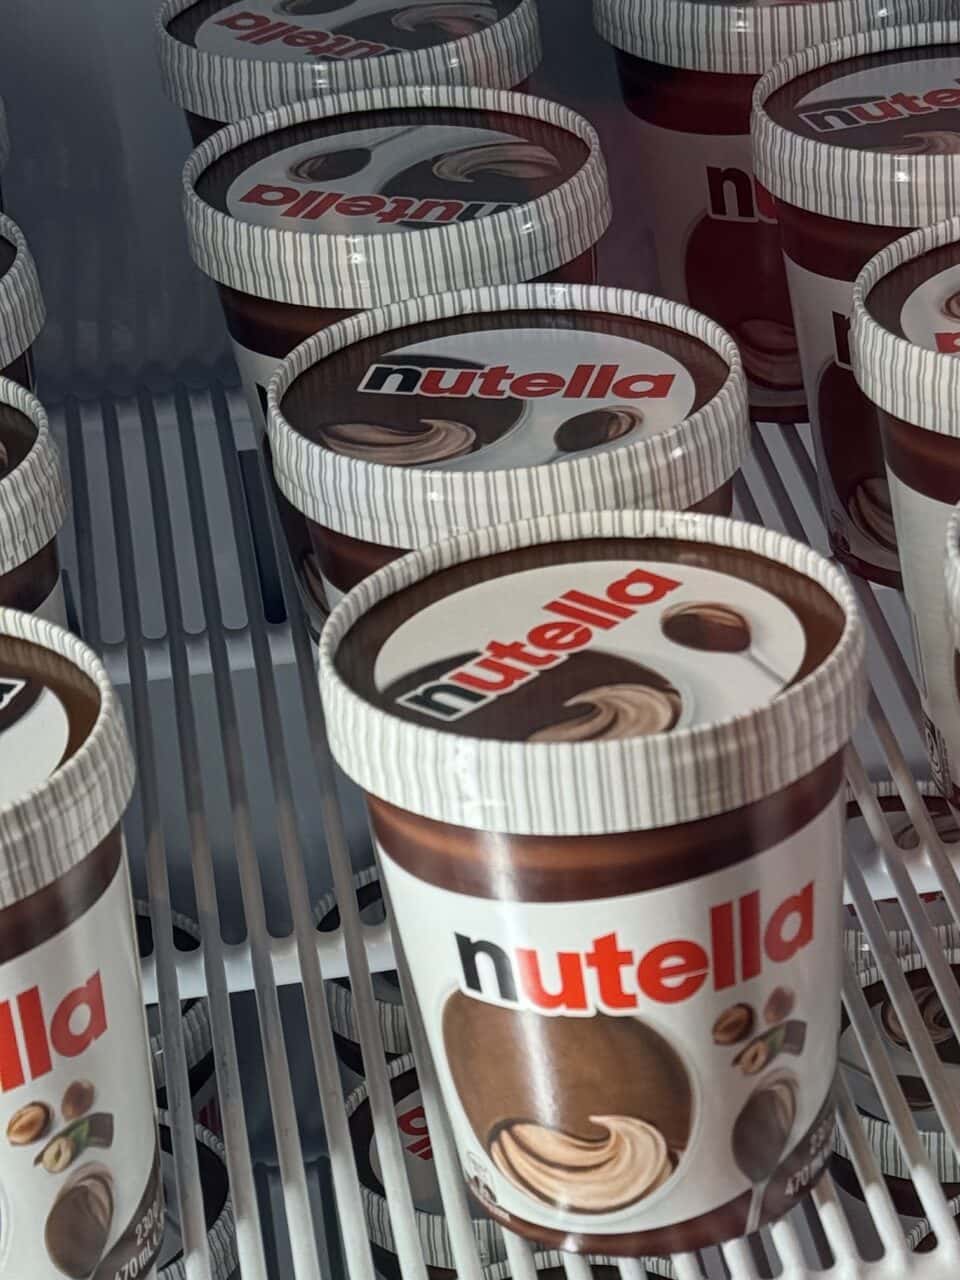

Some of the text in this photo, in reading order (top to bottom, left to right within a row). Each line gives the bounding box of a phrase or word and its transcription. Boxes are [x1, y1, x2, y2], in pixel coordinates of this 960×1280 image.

[361, 365, 676, 399] nutella
[399, 569, 682, 718] nutella
[455, 880, 814, 1011] nutella
